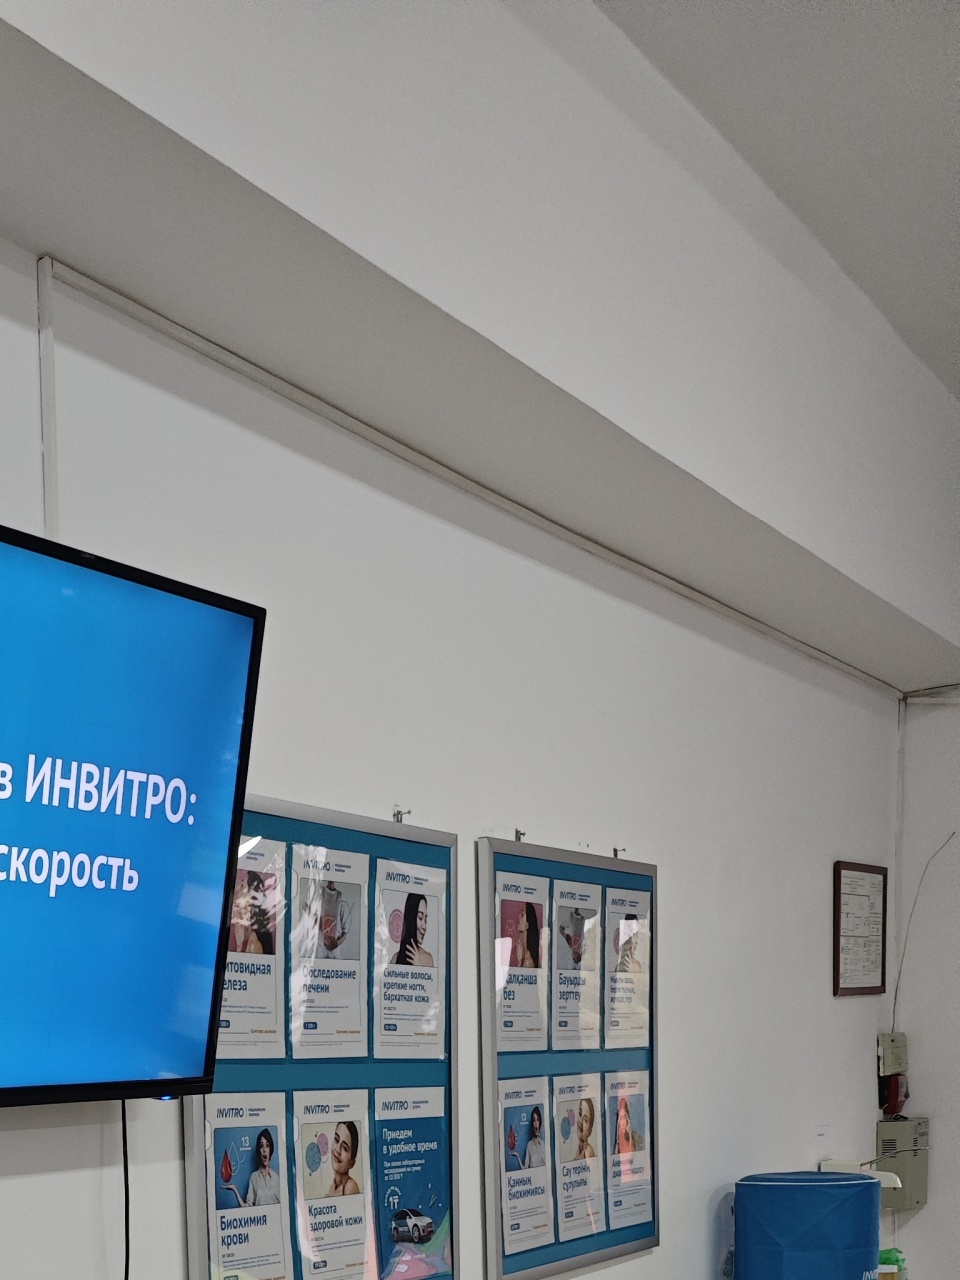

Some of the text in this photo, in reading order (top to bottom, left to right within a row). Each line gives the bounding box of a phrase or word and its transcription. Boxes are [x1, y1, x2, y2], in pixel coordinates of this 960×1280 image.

[24, 753, 197, 826] ИНВИТРО:
[386, 871, 410, 884] INVITRO
[225, 961, 272, 976] итовидная
[384, 967, 410, 980] Сильные
[222, 979, 248, 991] елеза
[302, 983, 330, 994] печени
[384, 982, 408, 992] крепкие
[503, 986, 516, 1000] без
[304, 1104, 330, 1115] INVITRO
[382, 1100, 408, 1111] INVITRO
[216, 1108, 244, 1118] INVITRO
[241, 1136, 250, 1146] 13
[382, 1128, 413, 1142] Приедем
[383, 1141, 437, 1156] в удобное время
[308, 1205, 337, 1219] Красота
[220, 1214, 267, 1231] Биохимия
[310, 1216, 363, 1233] здоровой кожи
[221, 1232, 249, 1250] крови
